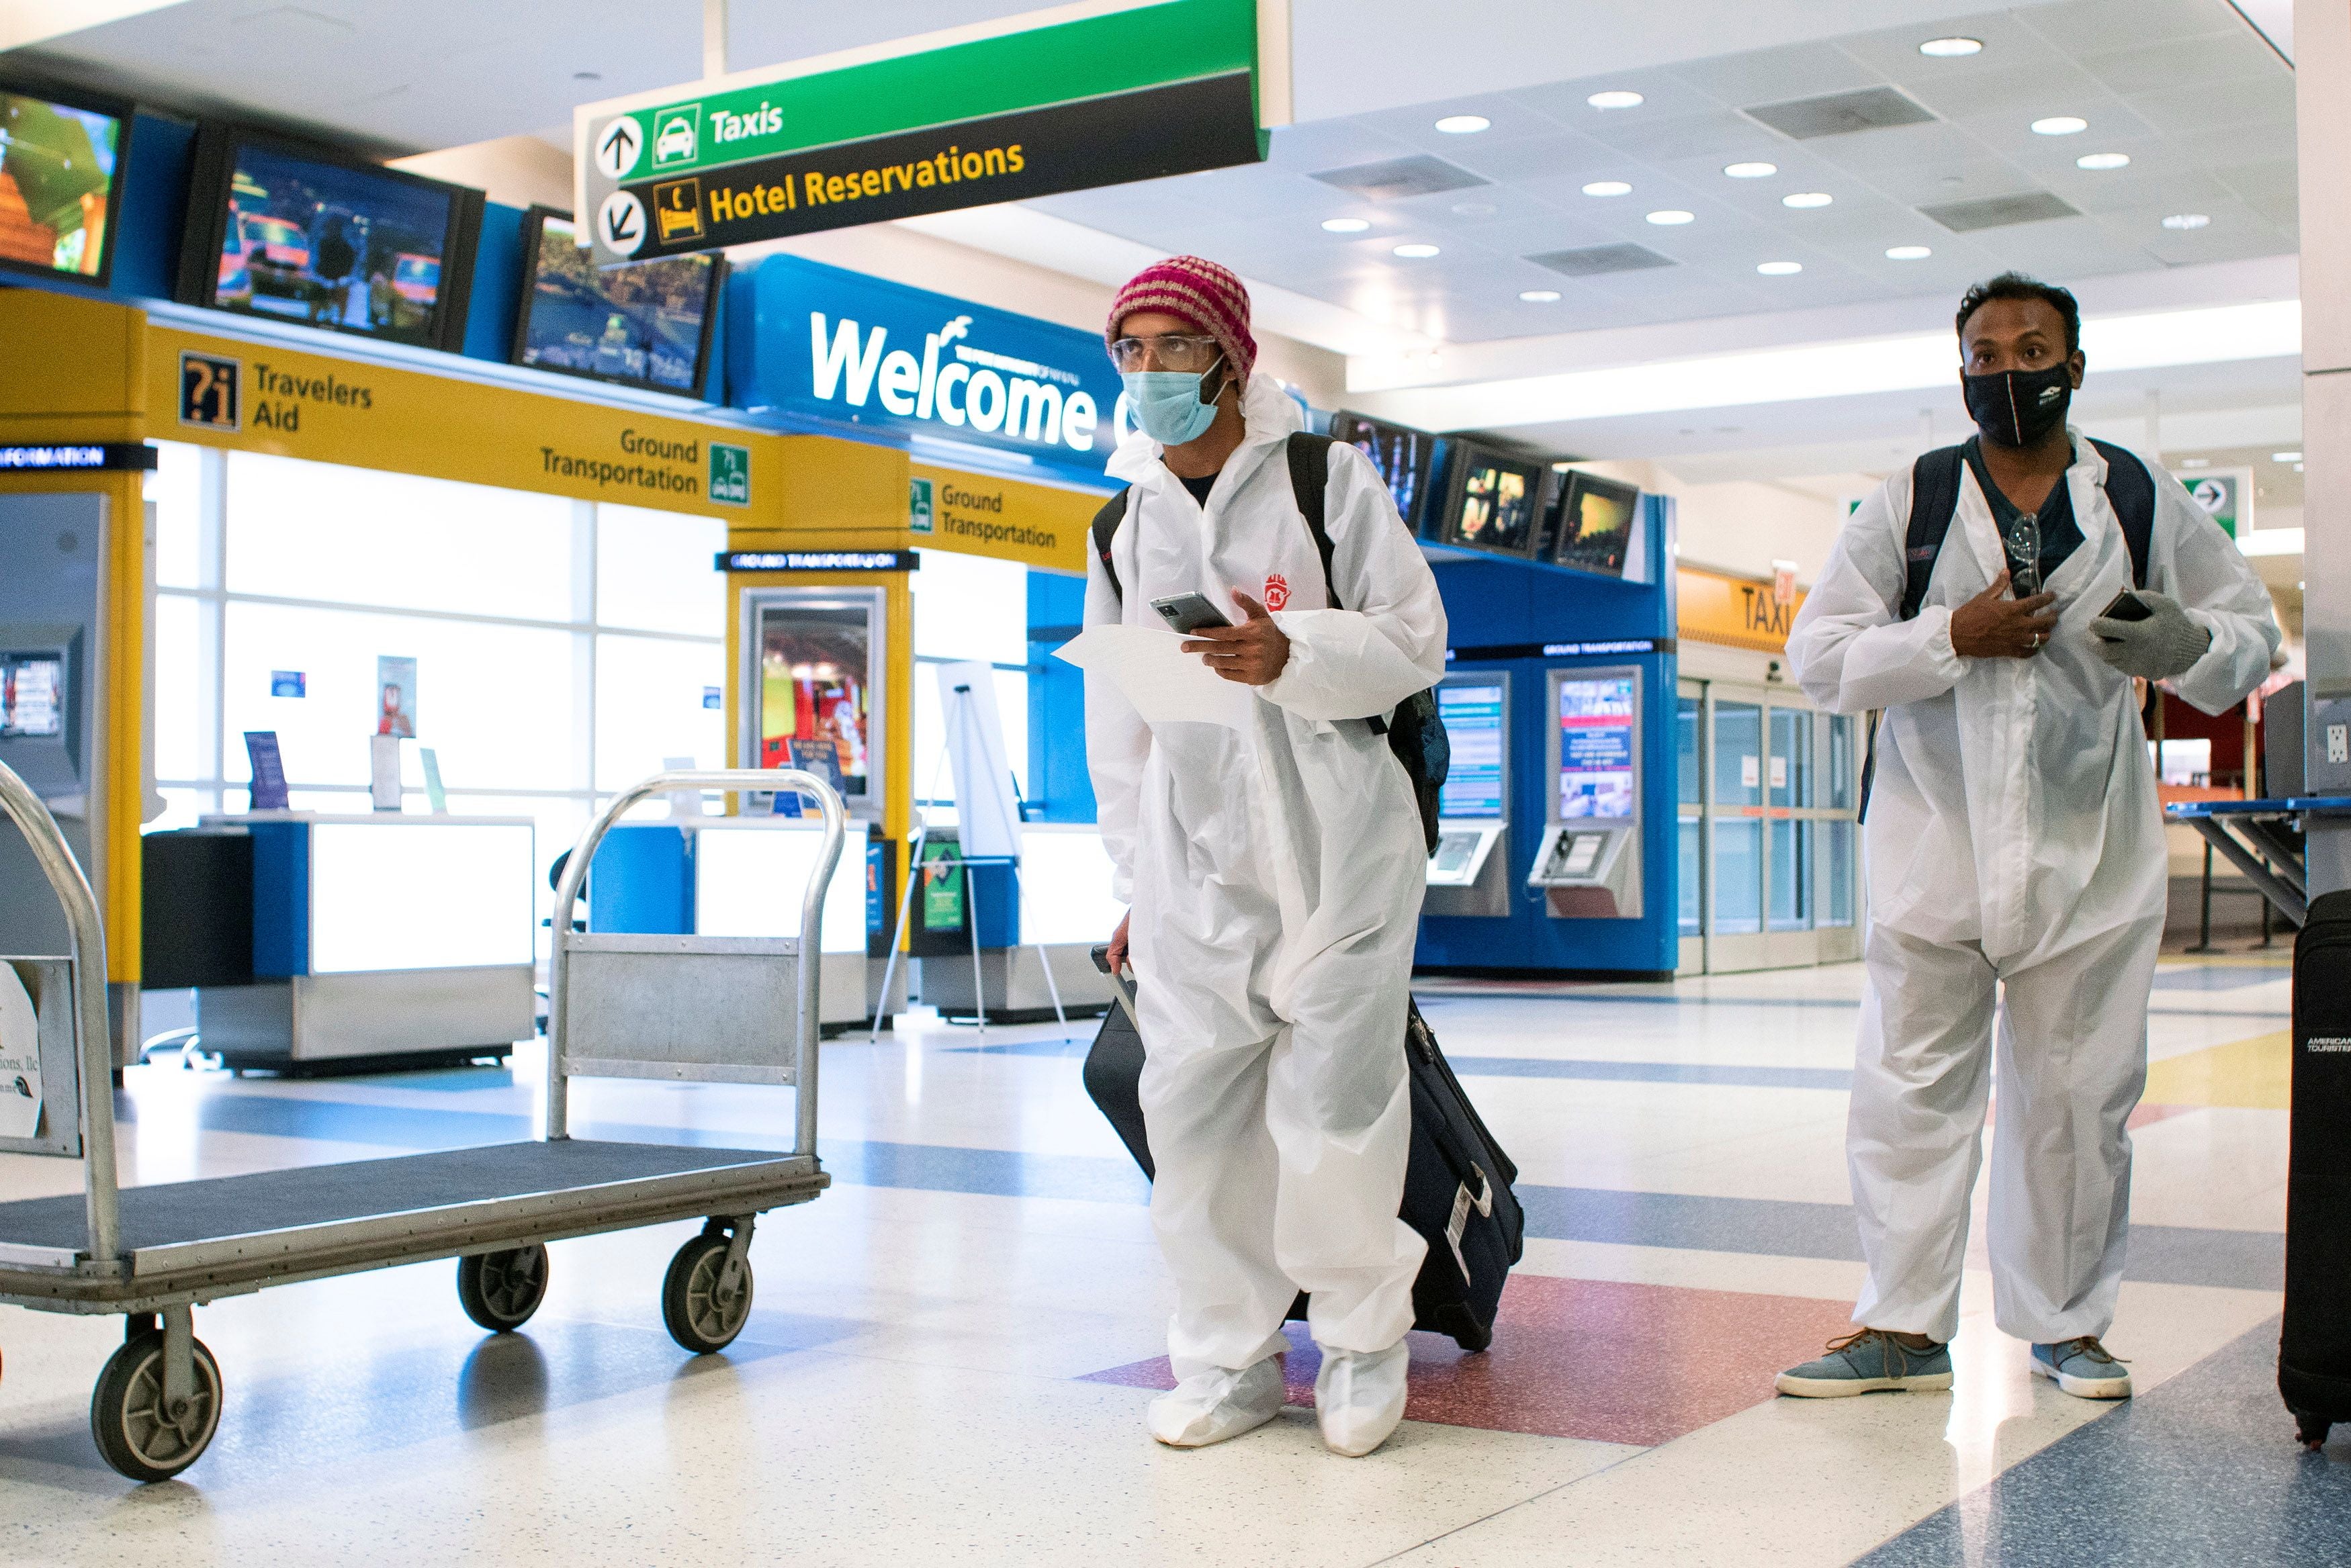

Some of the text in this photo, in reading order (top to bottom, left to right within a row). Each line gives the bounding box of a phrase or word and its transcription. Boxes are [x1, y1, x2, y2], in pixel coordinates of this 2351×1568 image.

[710, 101, 783, 143] Taxis
[709, 144, 1025, 223] Hotel Reservations
[254, 363, 372, 409] Travelers
[811, 311, 1098, 451] Welcome
[253, 401, 300, 432] Aid
[620, 428, 698, 464] Ground
[541, 446, 698, 494] Transportation
[942, 484, 1003, 513] Ground
[942, 511, 1057, 548] Transportation
[731, 553, 787, 568] GROUND
[1544, 640, 1653, 656] GROUND TRANSPORTATION
